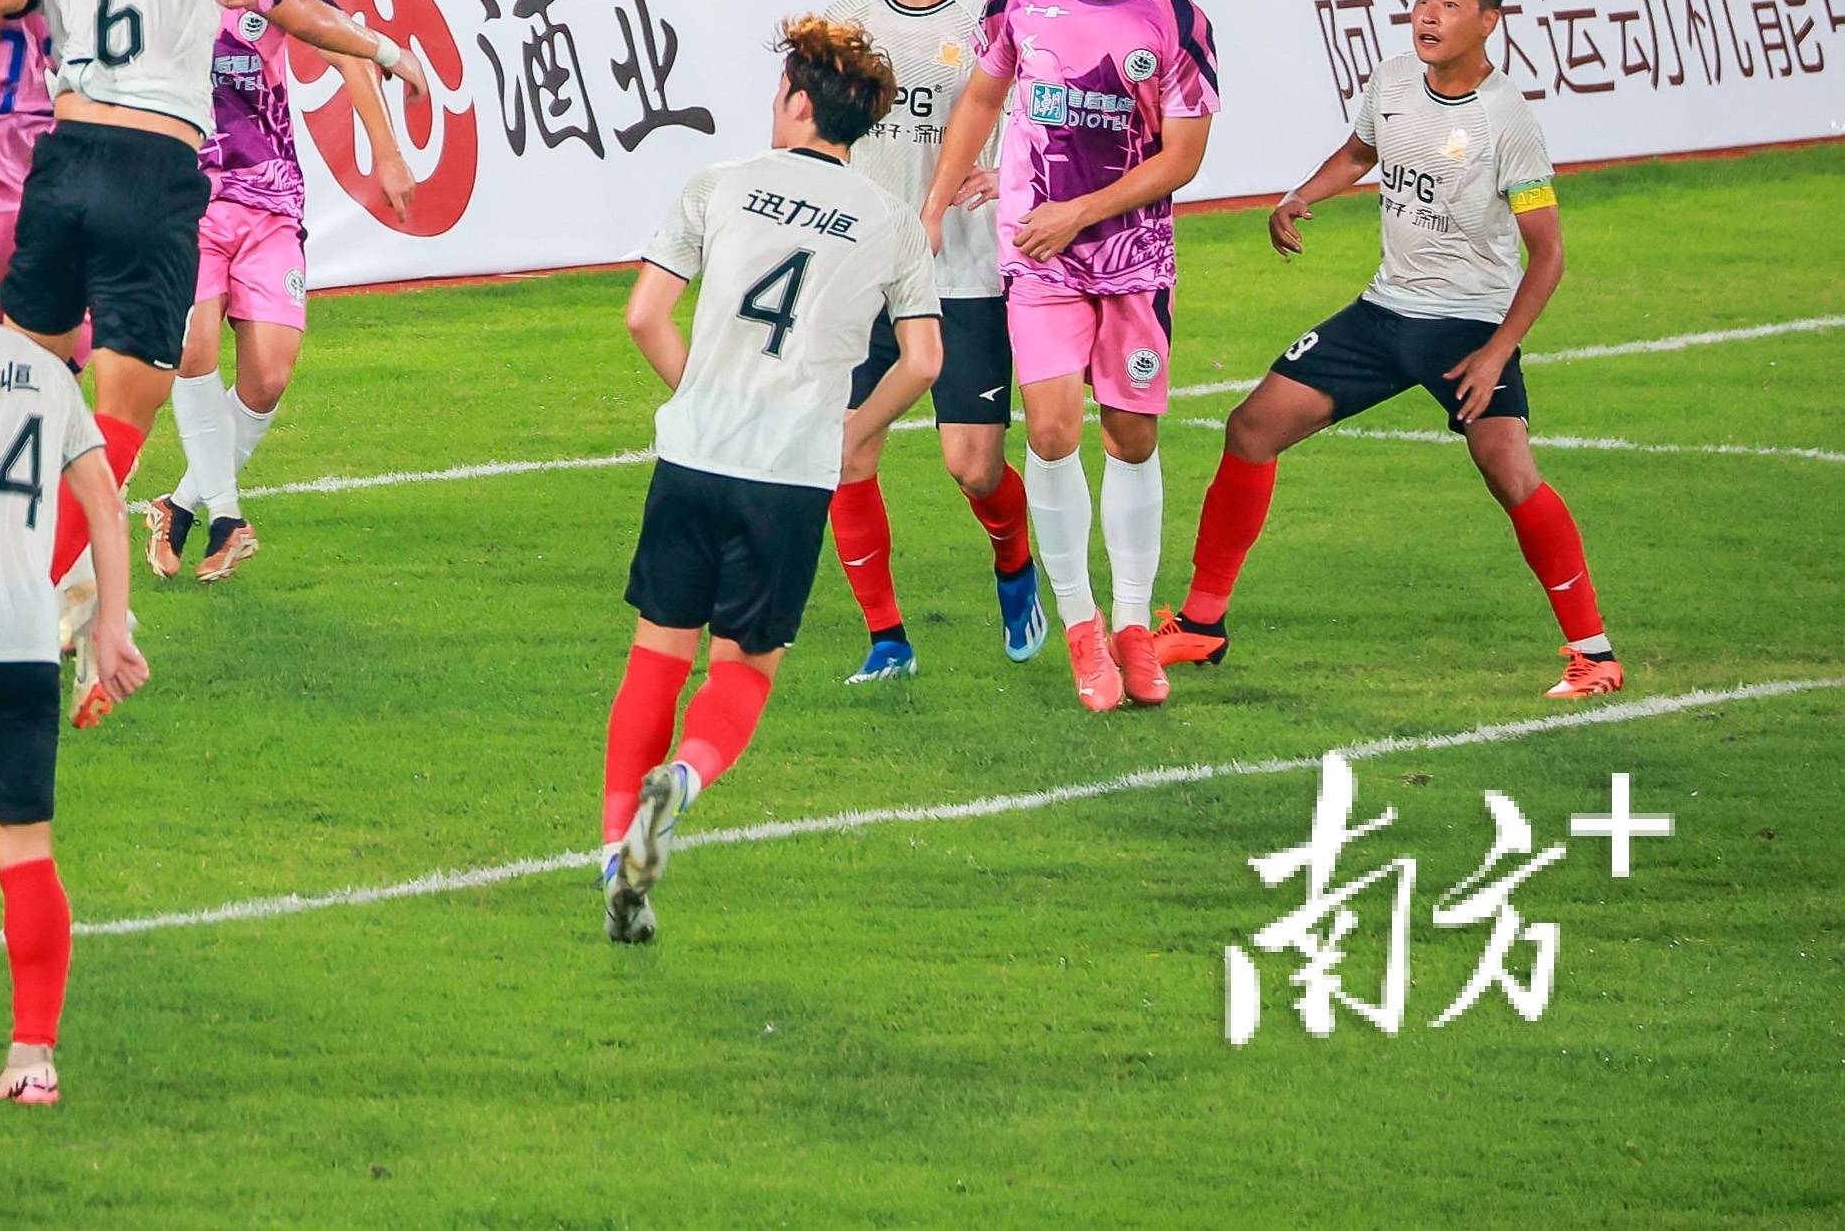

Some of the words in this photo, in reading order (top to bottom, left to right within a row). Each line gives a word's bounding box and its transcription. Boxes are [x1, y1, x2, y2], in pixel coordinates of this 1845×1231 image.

[742, 189, 859, 243] 迅力恒
[735, 246, 817, 361] 4
